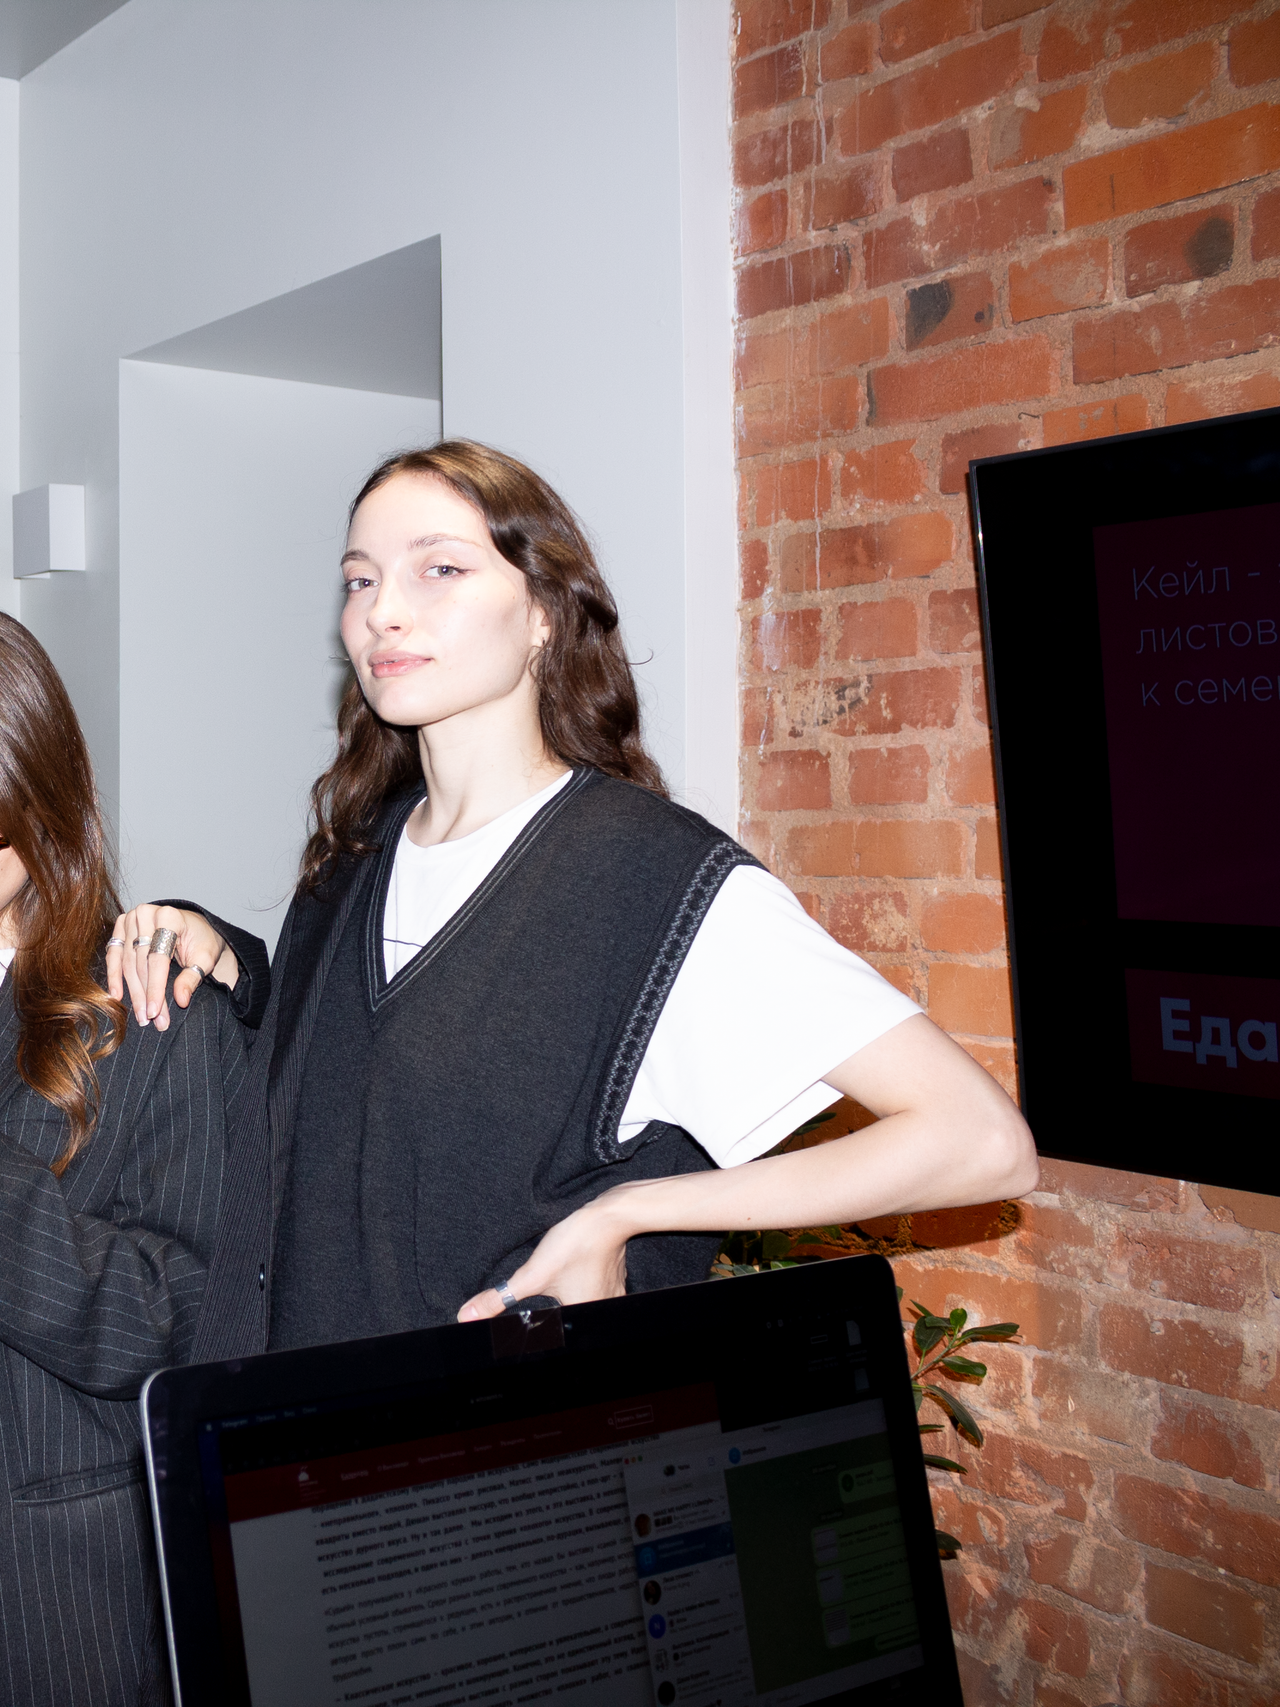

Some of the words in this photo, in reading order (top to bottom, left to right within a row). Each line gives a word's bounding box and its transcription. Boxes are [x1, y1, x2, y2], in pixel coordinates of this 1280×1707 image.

[1132, 560, 1230, 600] Кейл
[1136, 618, 1278, 653] листов
[1142, 681, 1161, 706] к
[1159, 997, 1278, 1068] Еда
